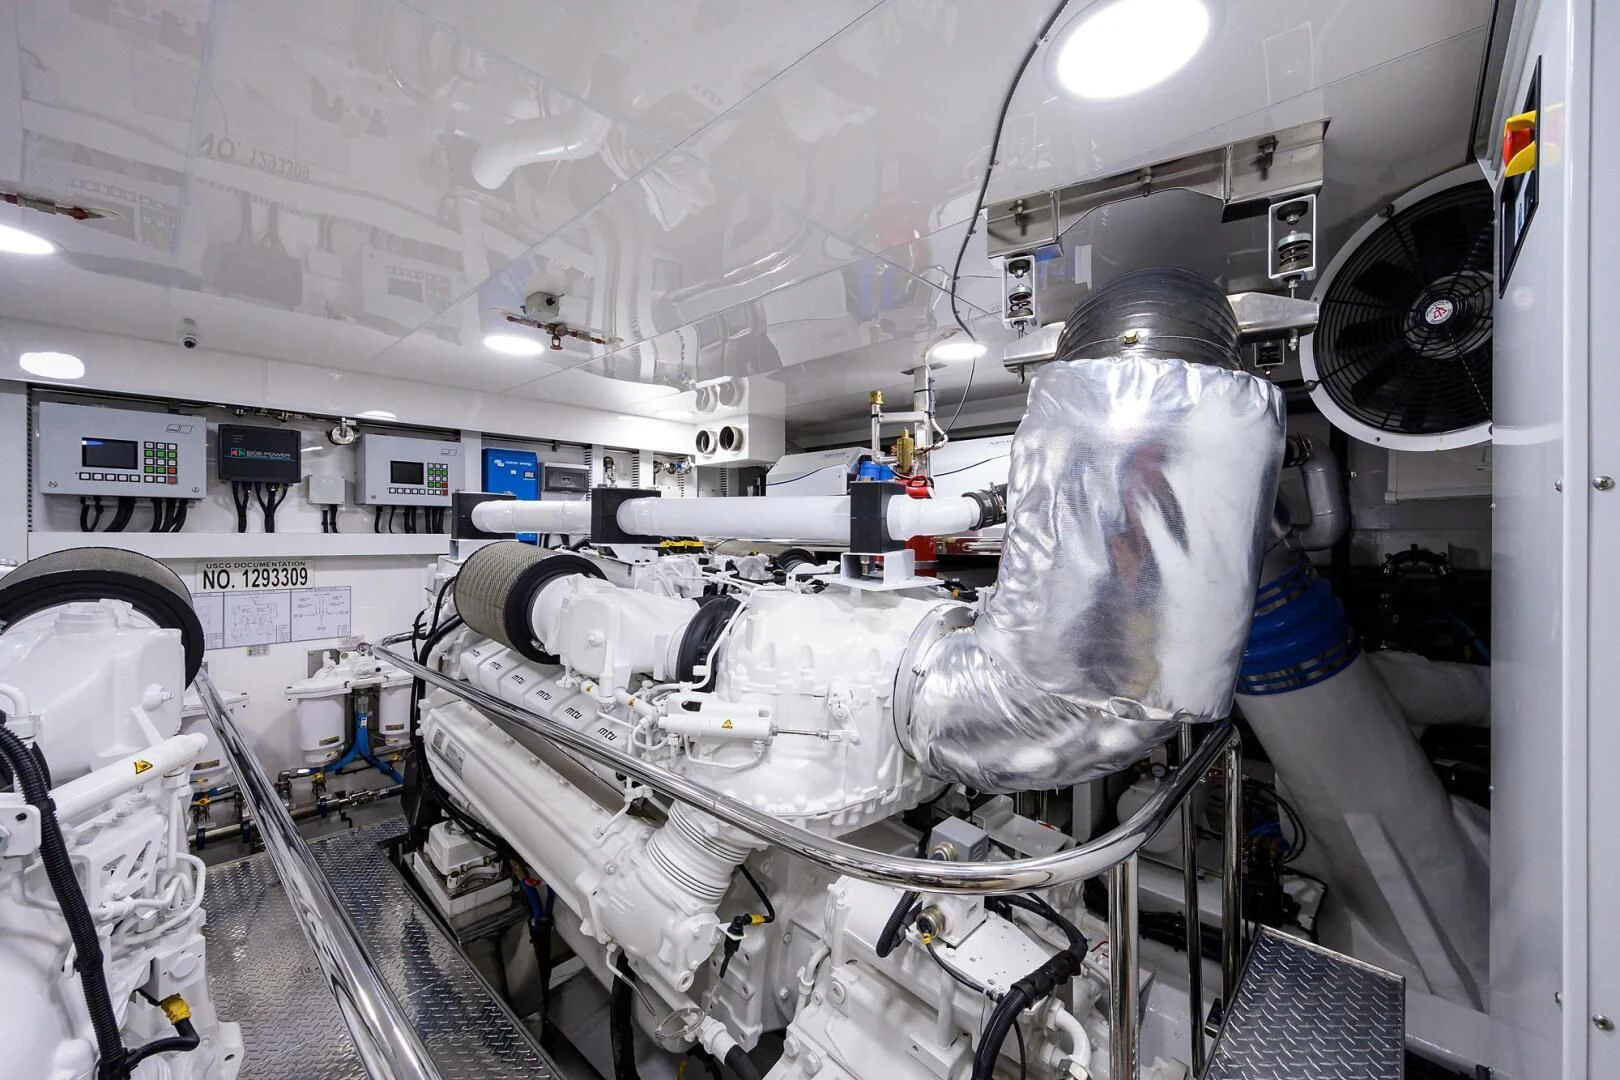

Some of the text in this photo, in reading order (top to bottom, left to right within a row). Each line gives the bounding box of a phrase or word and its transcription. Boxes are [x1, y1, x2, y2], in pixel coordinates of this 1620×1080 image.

[234, 561, 306, 569] DOCUMENTATION
[203, 567, 308, 590] NO. 1293309
[488, 661, 503, 671] mtu
[511, 674, 526, 685] mtu
[536, 689, 553, 701] mtu
[564, 706, 583, 720] mtu
[597, 727, 618, 741] mtu
